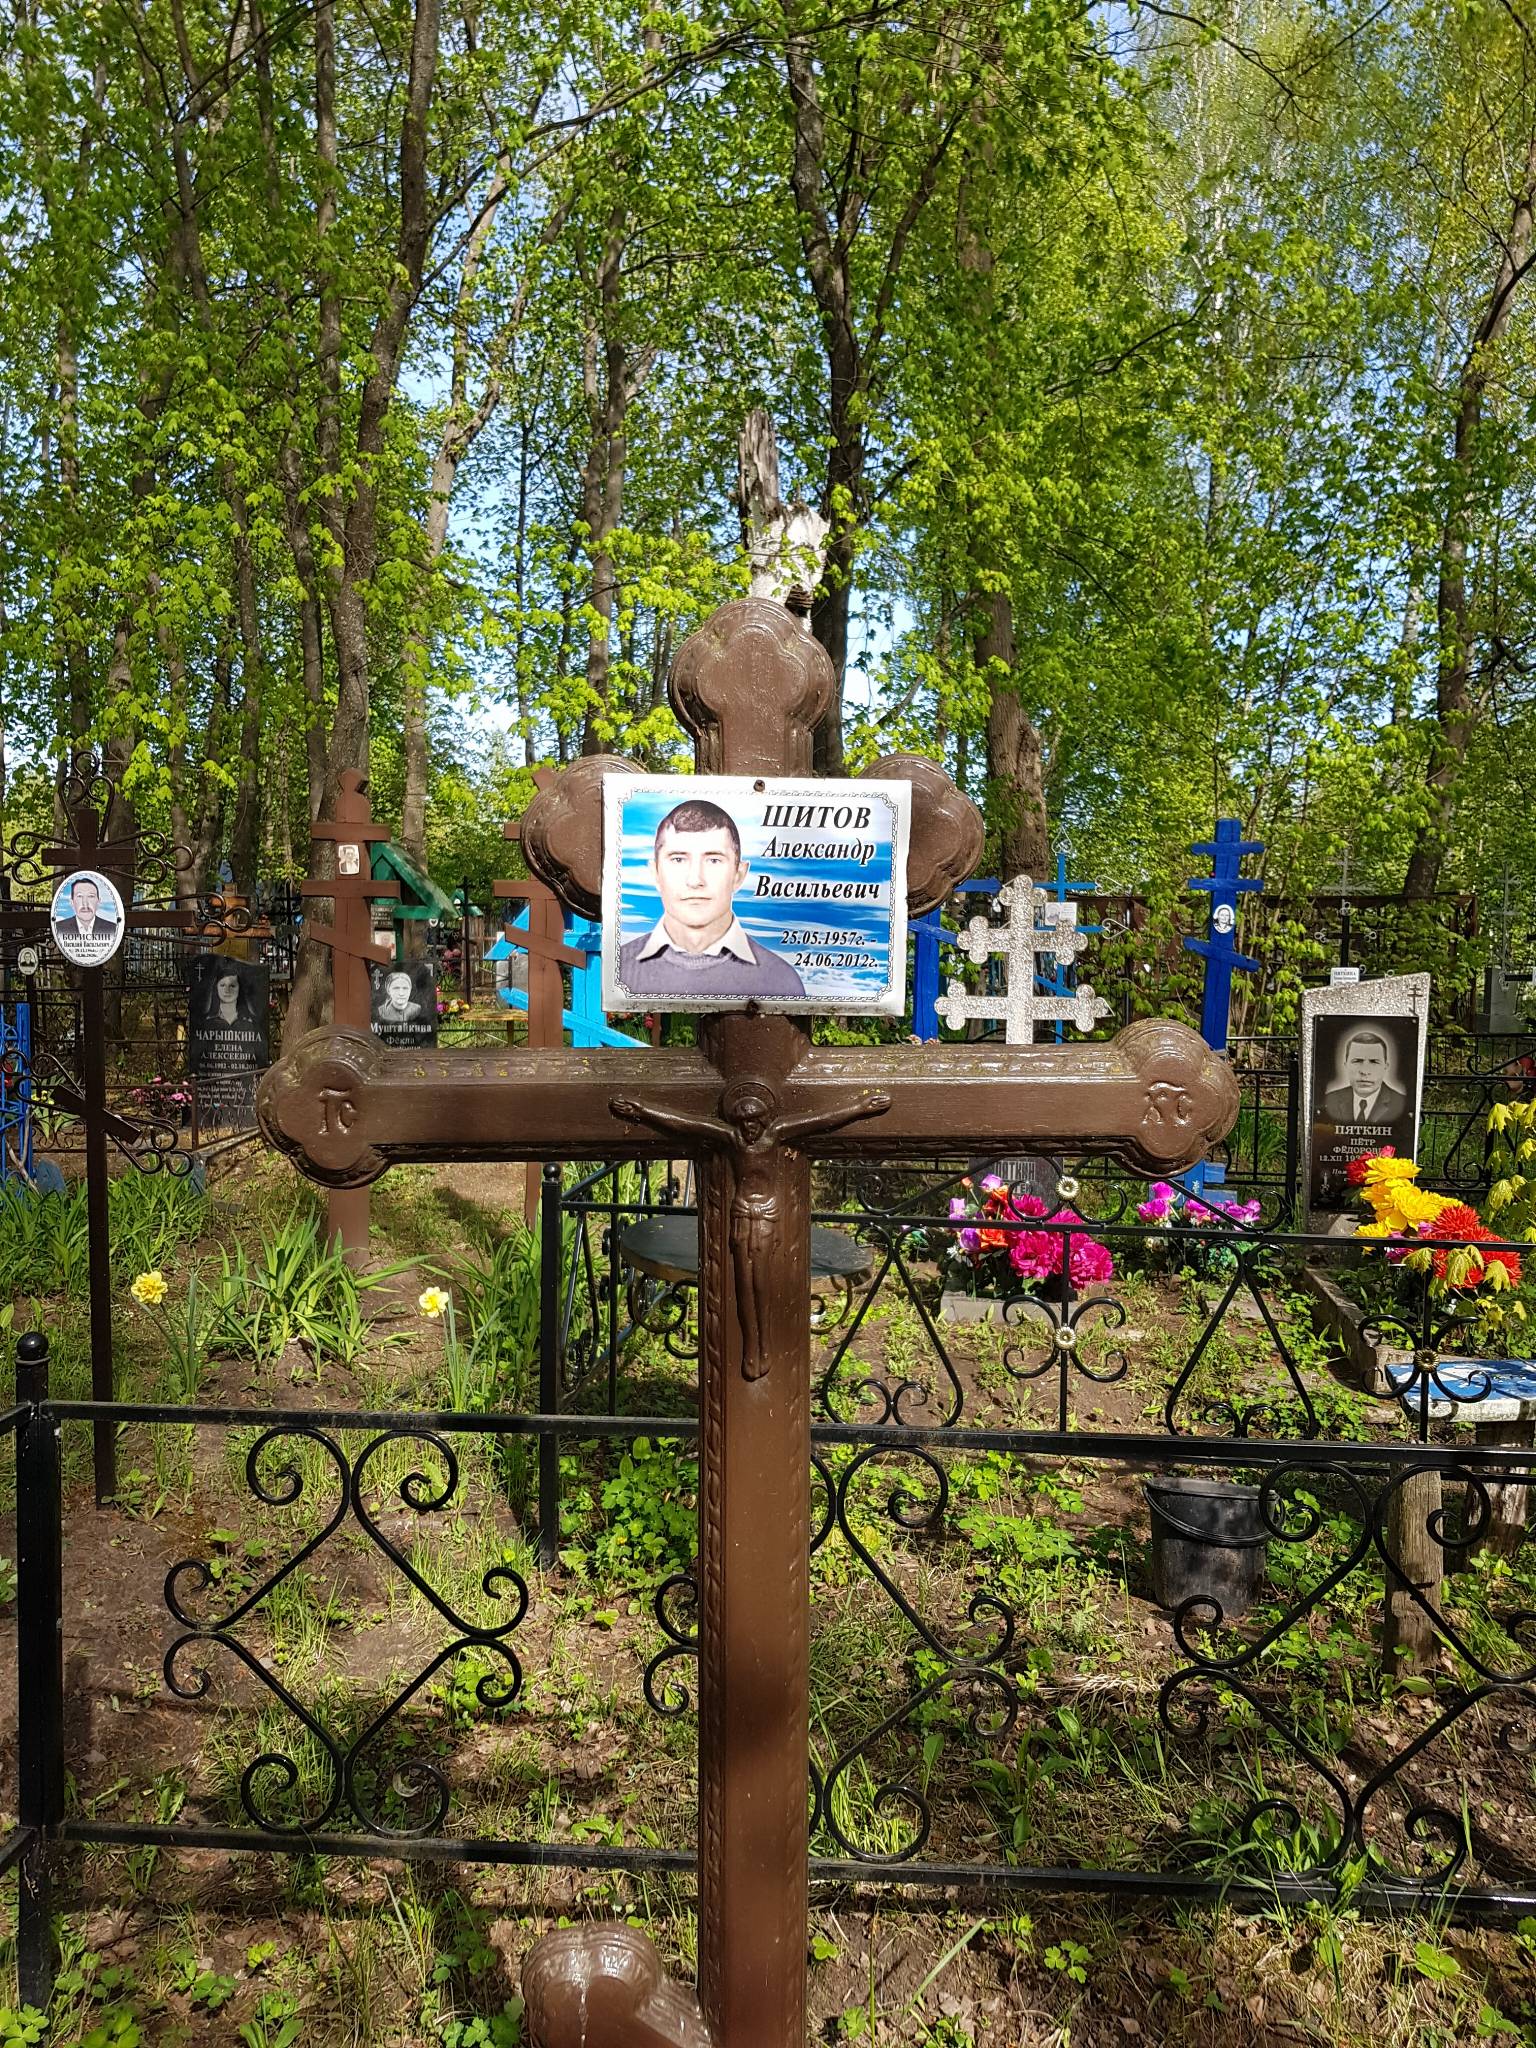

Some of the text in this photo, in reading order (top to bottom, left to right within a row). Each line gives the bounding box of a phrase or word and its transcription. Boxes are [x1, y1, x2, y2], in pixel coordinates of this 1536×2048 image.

[760, 805, 871, 829] ШИТОВ
[761, 835, 875, 866] Александр
[753, 875, 880, 899] Васильевич
[781, 931, 865, 946] 25.05.1957г.
[794, 953, 878, 968] 24.06.2012г.
[195, 1029, 262, 1042] ЧАРЫШКИНА
[214, 1043, 243, 1052] ЕЛЕНА
[200, 1051, 257, 1061] АЛЕКСЕЕВНА
[1335, 1125, 1392, 1136] ПЯТКИН
[1350, 1137, 1376, 1146] ПЁТР
